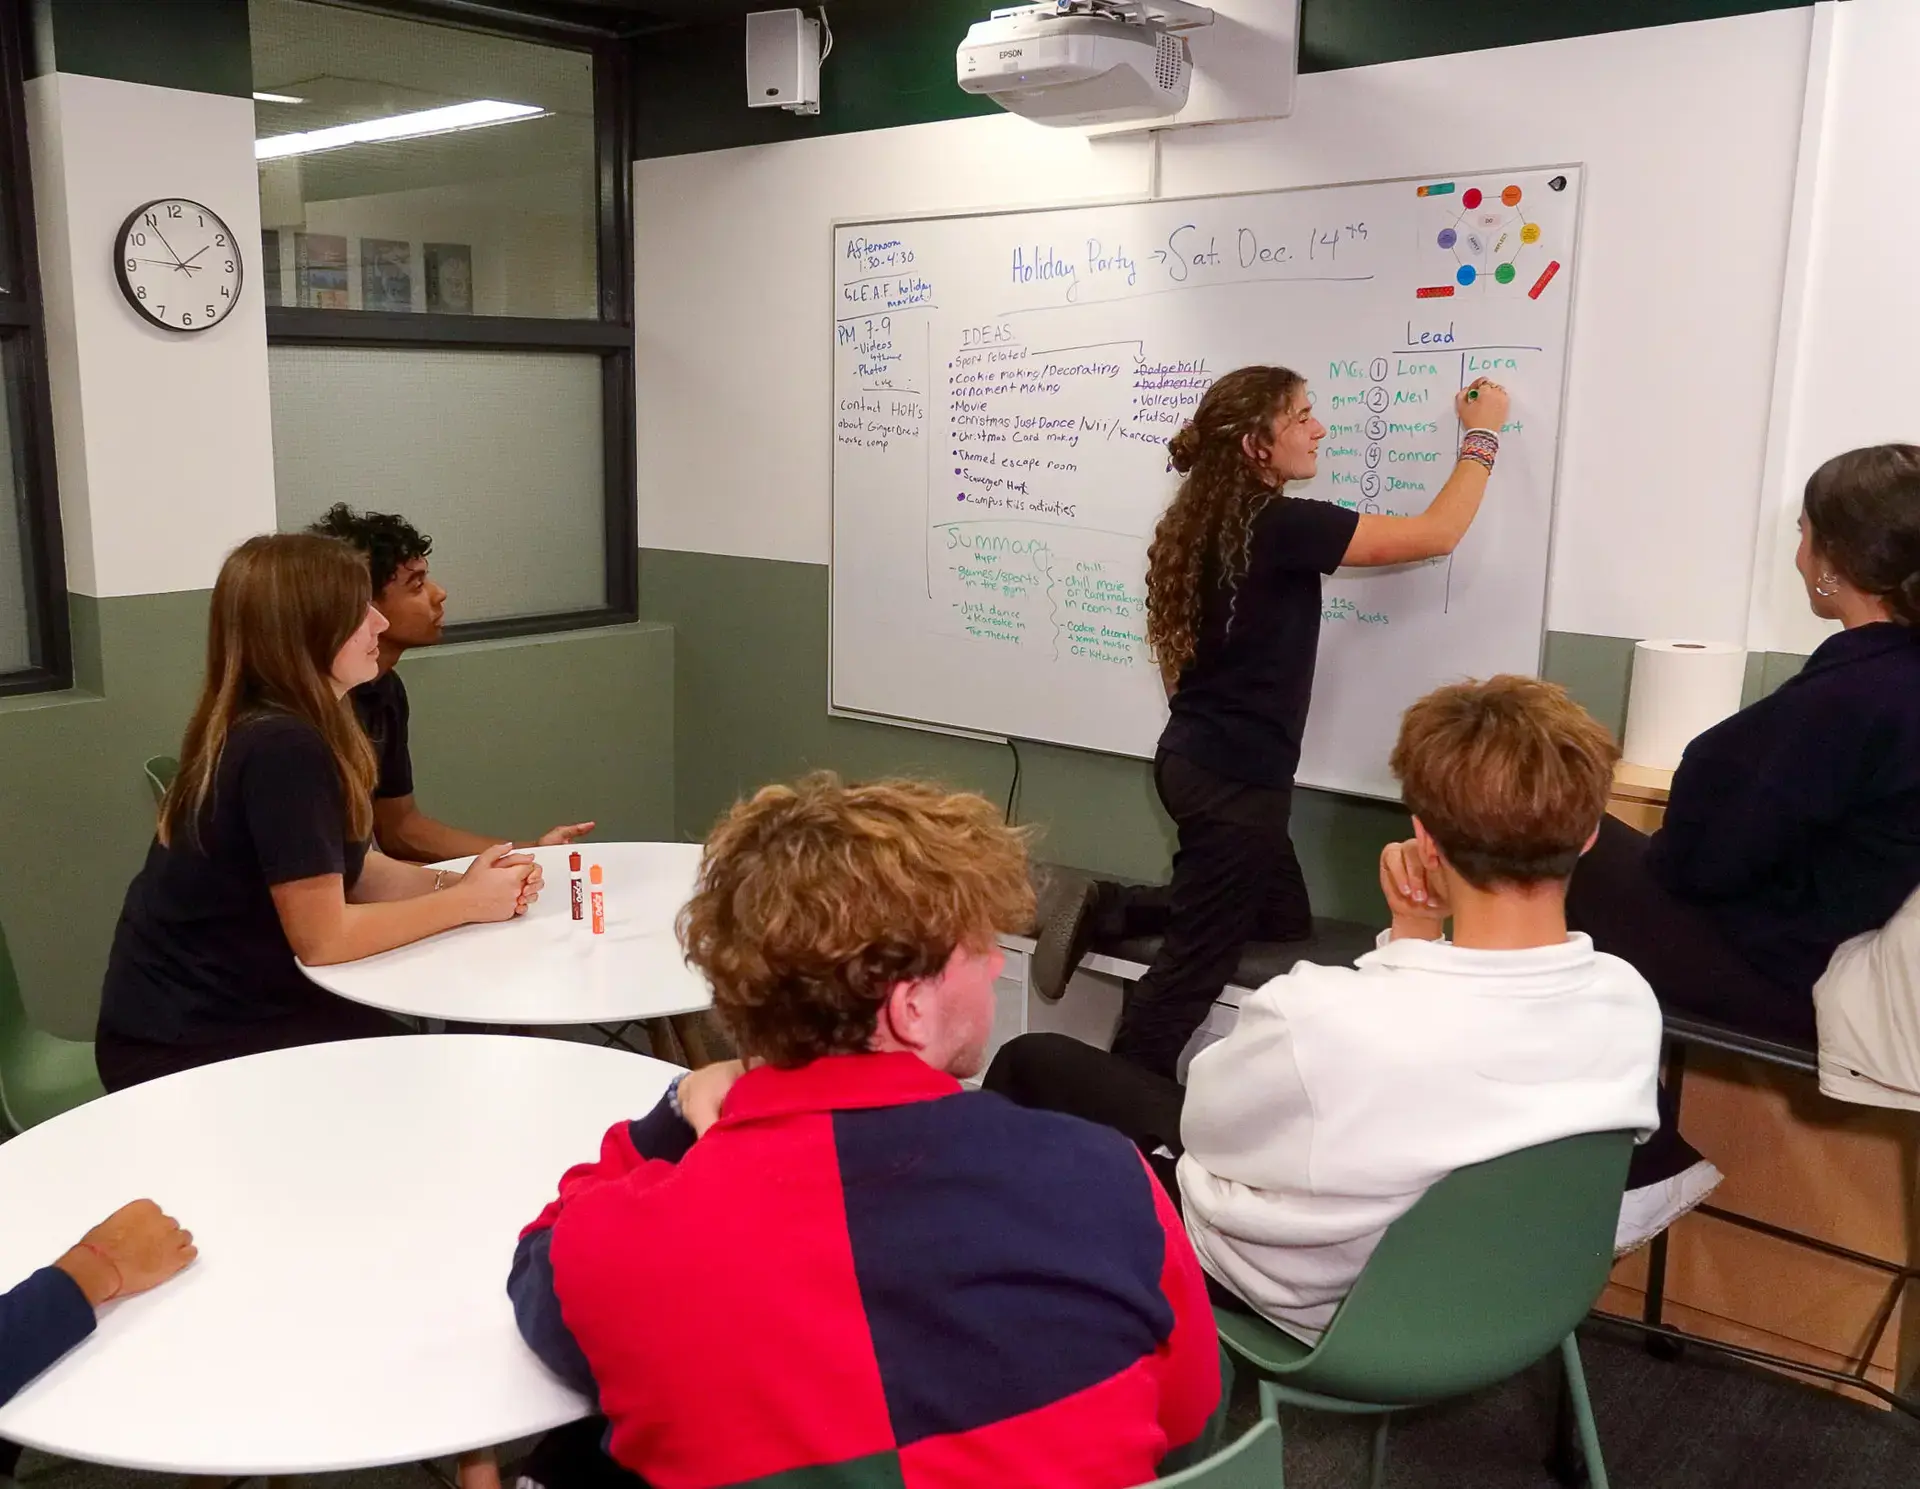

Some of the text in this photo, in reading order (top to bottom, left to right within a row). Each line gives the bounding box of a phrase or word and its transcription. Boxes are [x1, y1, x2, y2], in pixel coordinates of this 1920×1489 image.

[999, 49, 1023, 60] EPSON
[166, 204, 182, 219] 12
[144, 213, 157, 226] 11
[198, 214, 204, 228] 1
[130, 232, 146, 246] 10
[215, 234, 226, 247] 2
[846, 237, 901, 260] Afternoon
[126, 258, 137, 272] 9
[224, 260, 234, 273] 3
[1012, 246, 1080, 303] Holiday
[1087, 238, 1137, 286] Party
[1169, 225, 1220, 281] Sat.
[1240, 228, 1292, 268] Dec.
[136, 285, 147, 300] 8
[221, 285, 230, 298] 4
[156, 305, 166, 318] 7
[205, 304, 216, 318] 5
[182, 312, 192, 326] 6
[838, 325, 856, 346] PM
[1406, 321, 1455, 346] Lead
[987, 347, 1028, 362] related
[1397, 359, 1438, 376] Lora
[1468, 355, 1518, 371] Lora
[1393, 388, 1429, 405] Neil
[955, 401, 987, 412] Movie
[838, 417, 864, 430] about
[1139, 409, 1180, 425] Futsal
[1002, 458, 1040, 471] escape
[1047, 461, 1077, 472] room
[1384, 475, 1426, 491] Jenna
[1029, 500, 1077, 517] activities
[989, 606, 1020, 619] dance
[1081, 602, 1112, 614] room
[1103, 641, 1132, 652] music
